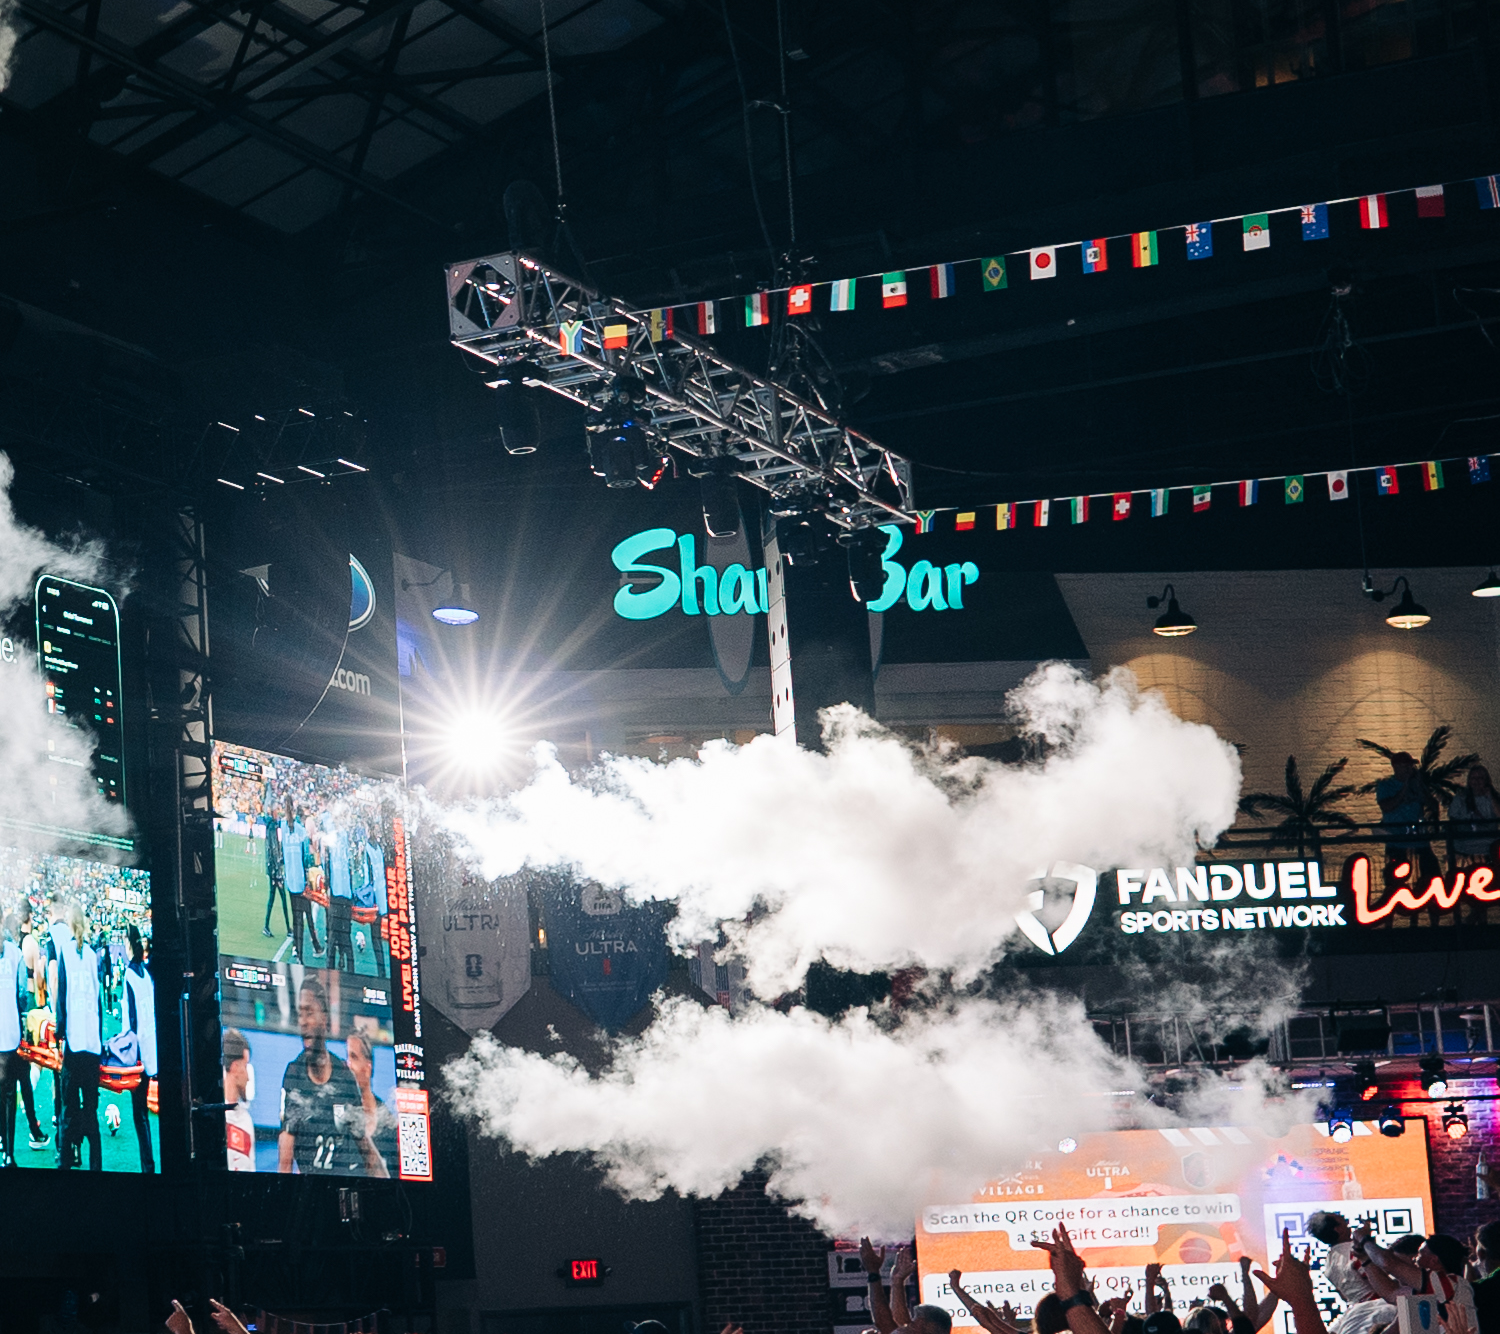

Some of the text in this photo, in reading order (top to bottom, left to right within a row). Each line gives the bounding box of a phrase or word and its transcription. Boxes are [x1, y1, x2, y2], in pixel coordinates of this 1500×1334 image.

[865, 525, 980, 613] Bar
[1116, 862, 1338, 905] FANDUEL
[1120, 903, 1347, 934] SPORTS NETWORK
[574, 939, 640, 956] ULTRA
[1087, 1166, 1131, 1177] ULTRA
[979, 1184, 1045, 1196] VILLAGE
[930, 1201, 1234, 1225] Scan the QR Code for chance to win
[1101, 1223, 1150, 1240] Card!!
[572, 1260, 598, 1280] EXIT
[1020, 1278, 1036, 1292] el
[1106, 1274, 1131, 1291] QR
[1181, 1272, 1230, 1286] tener
